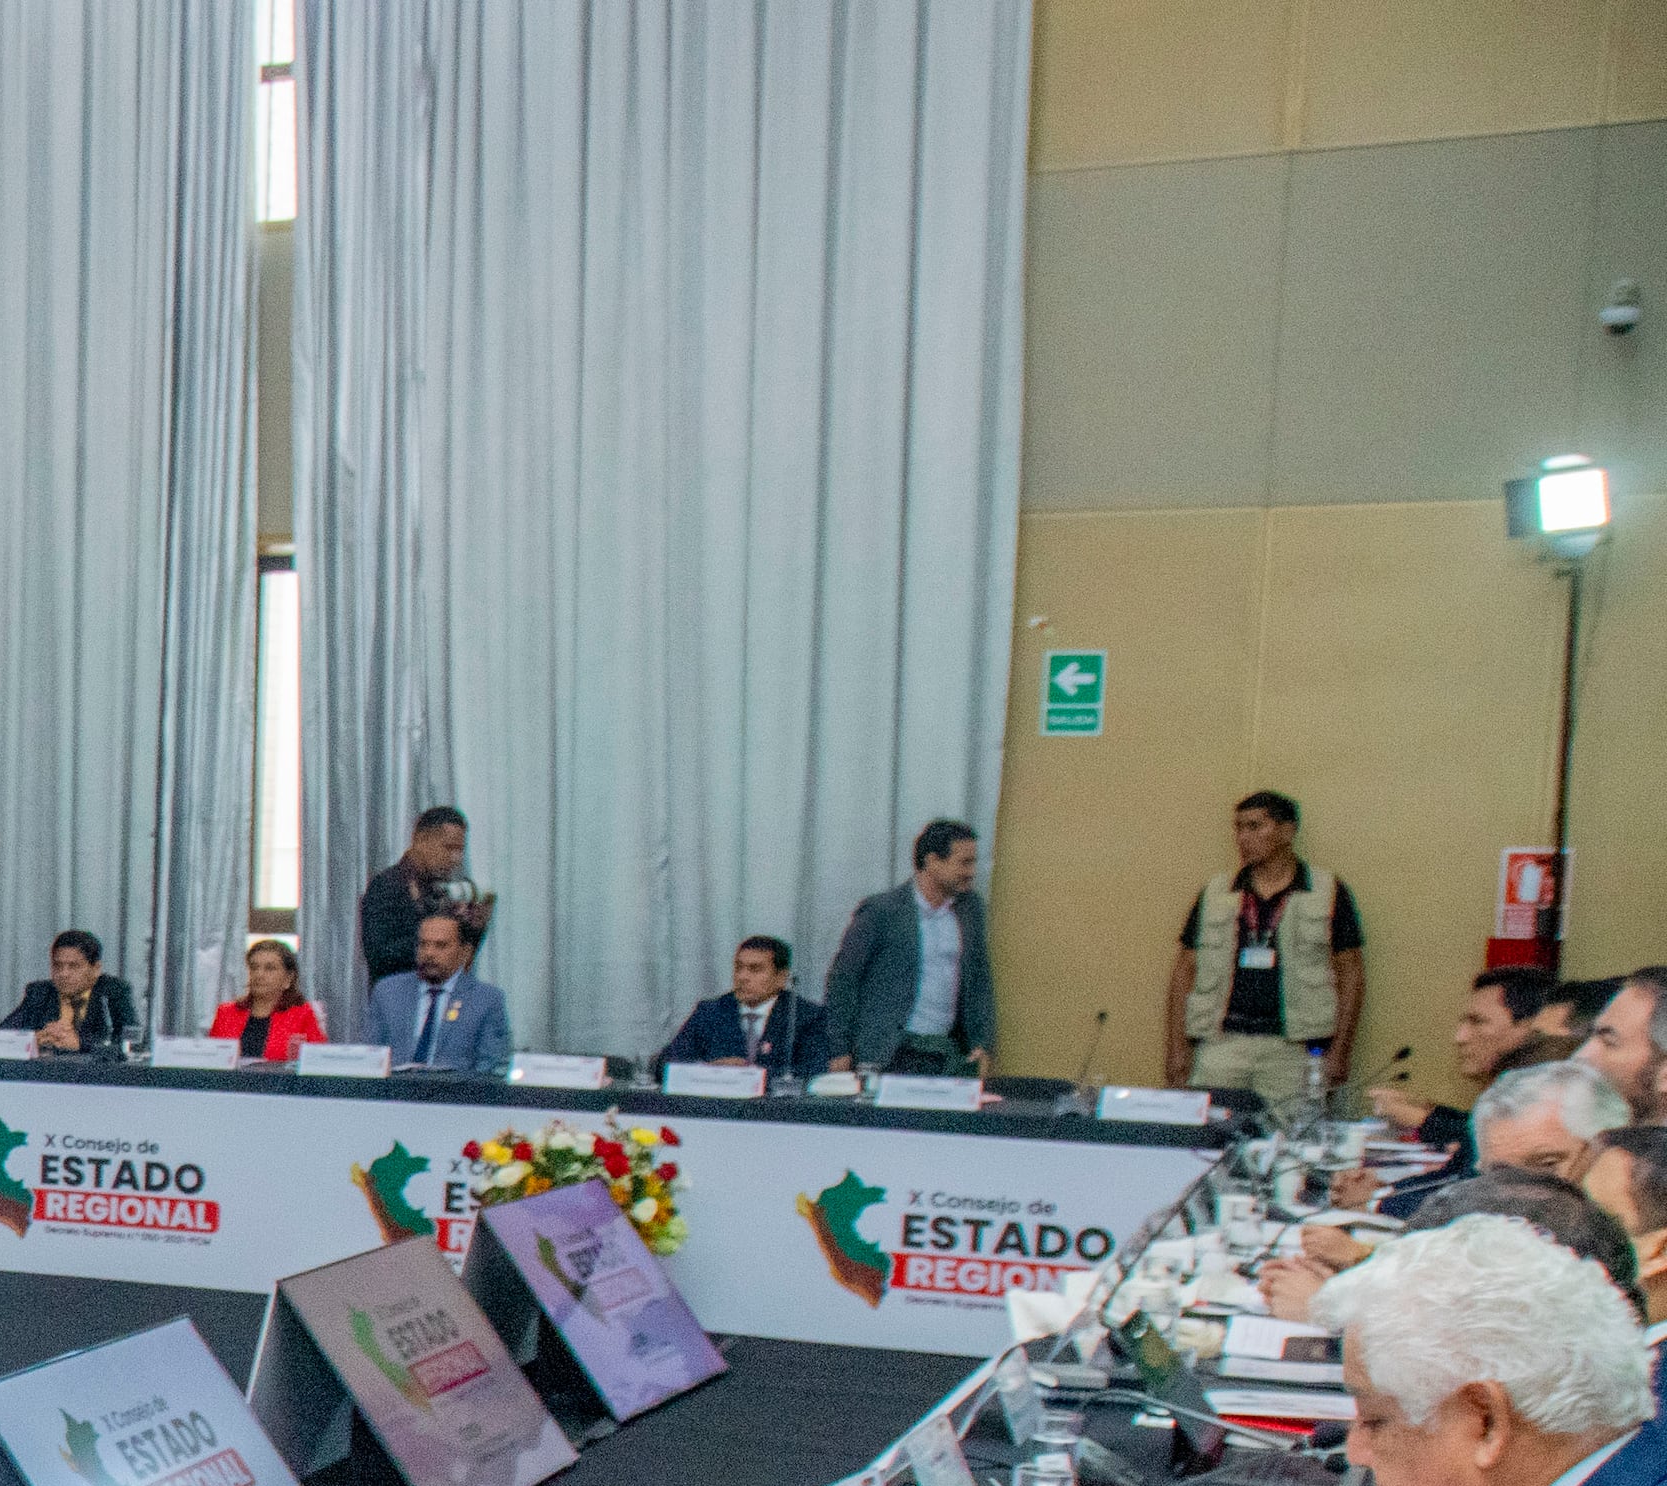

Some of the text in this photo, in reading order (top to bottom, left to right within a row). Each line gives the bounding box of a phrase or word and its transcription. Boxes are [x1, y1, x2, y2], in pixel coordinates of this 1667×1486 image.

[44, 1133, 159, 1154] X Consejo de
[40, 1153, 205, 1194] ESTADO
[45, 1193, 213, 1231] REGIONAL
[909, 1190, 1057, 1216] X Consejo de
[901, 1212, 1117, 1262] ESTADO
[115, 1409, 219, 1480] ESTADO
